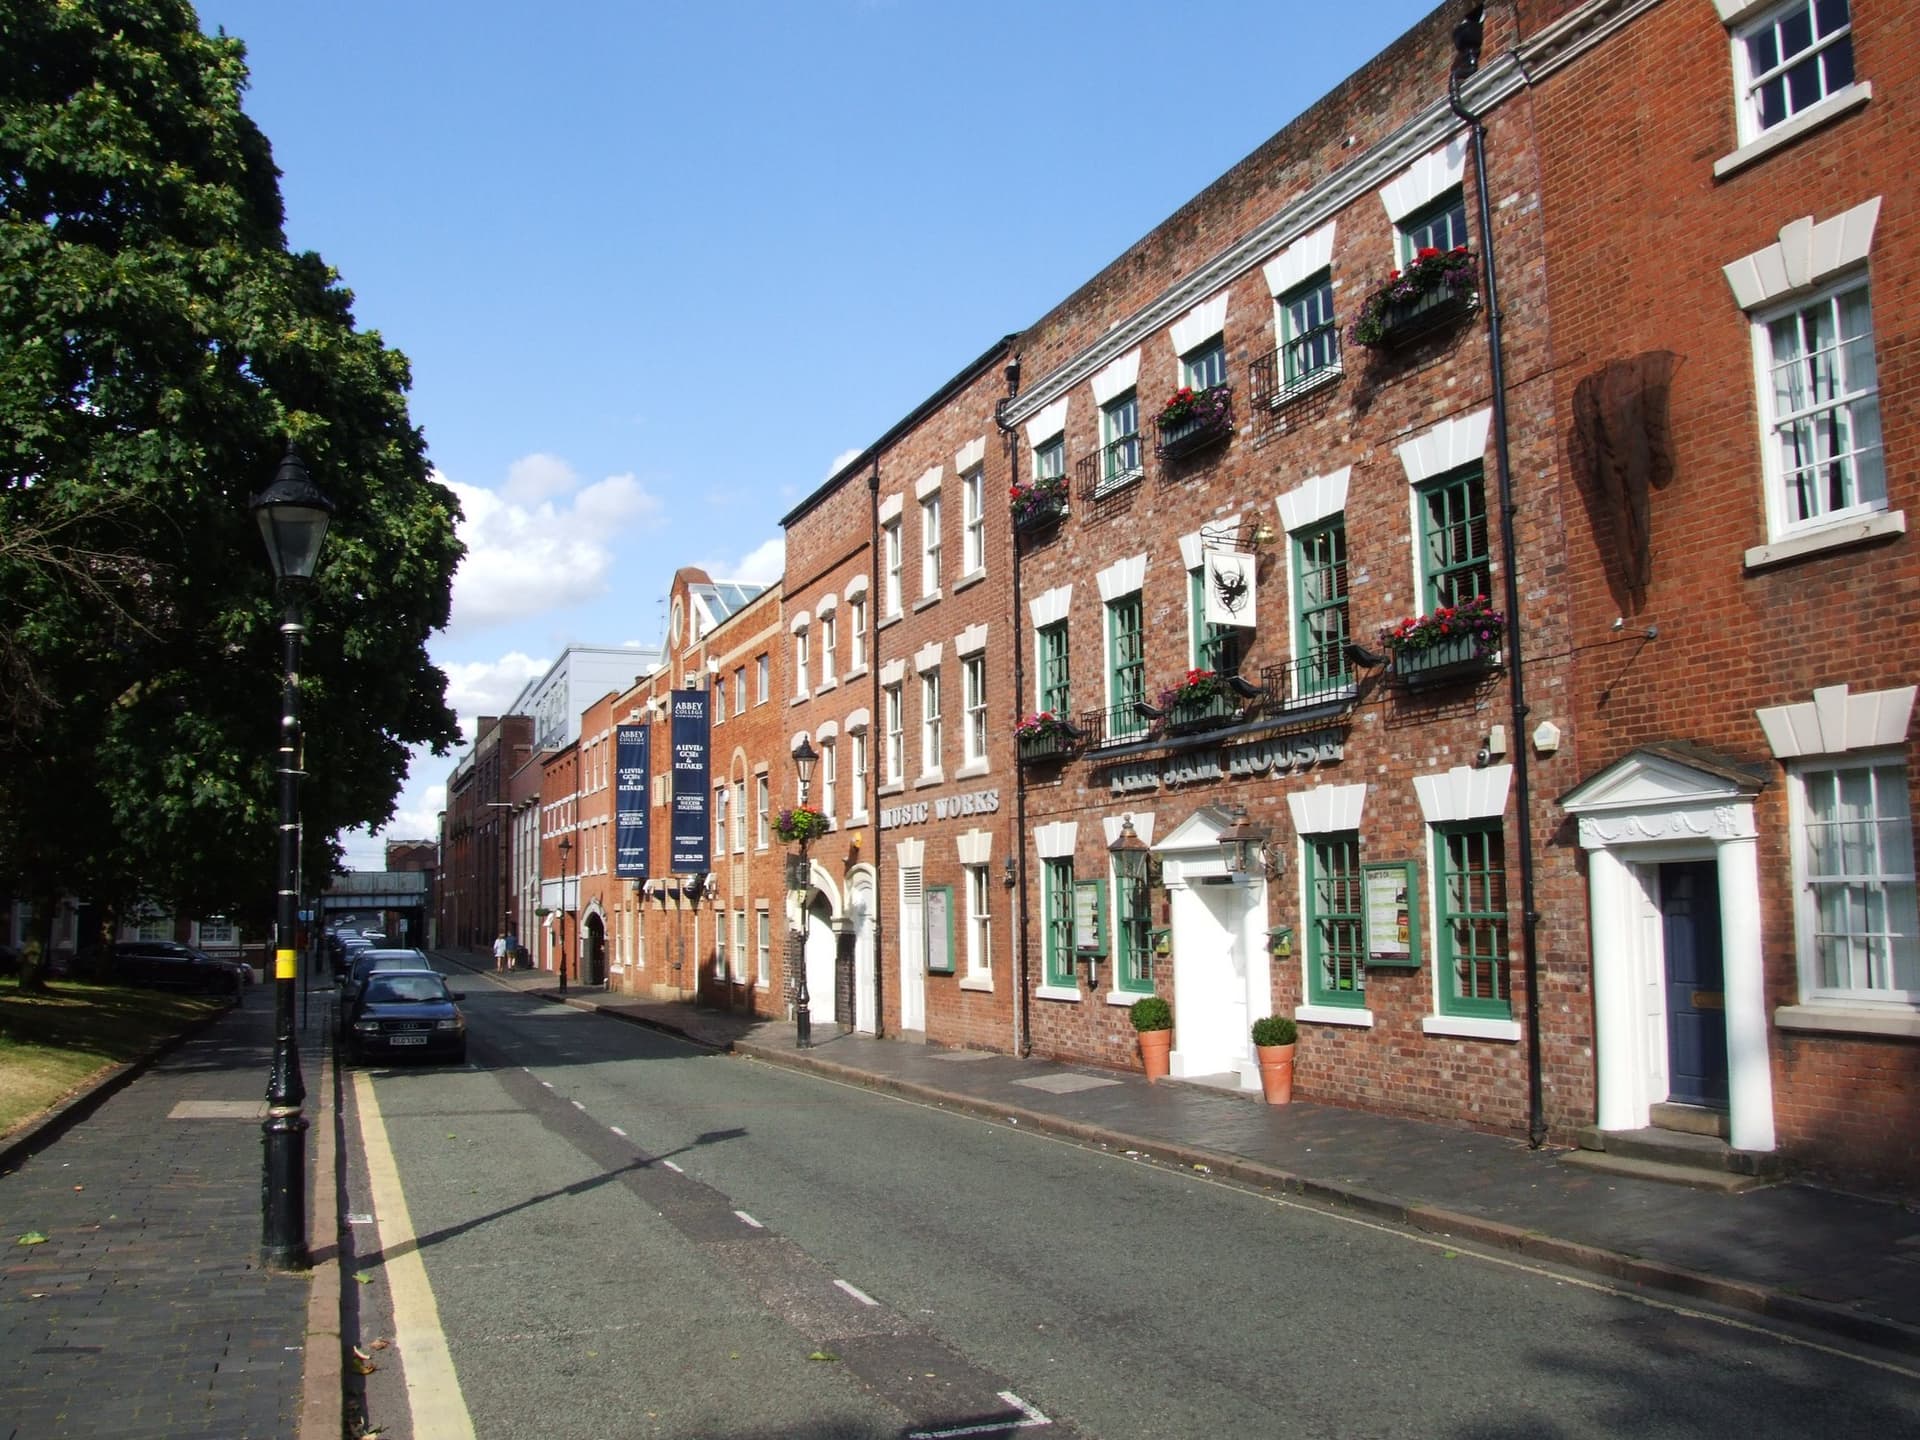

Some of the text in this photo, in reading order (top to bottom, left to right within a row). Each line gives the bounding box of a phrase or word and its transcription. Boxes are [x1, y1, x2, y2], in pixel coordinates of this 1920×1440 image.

[675, 702, 703, 710] ABBEY
[1163, 751, 1224, 786] JAM
[1229, 733, 1344, 775] HOUSE
[880, 789, 999, 829] MUSIC WORKS
